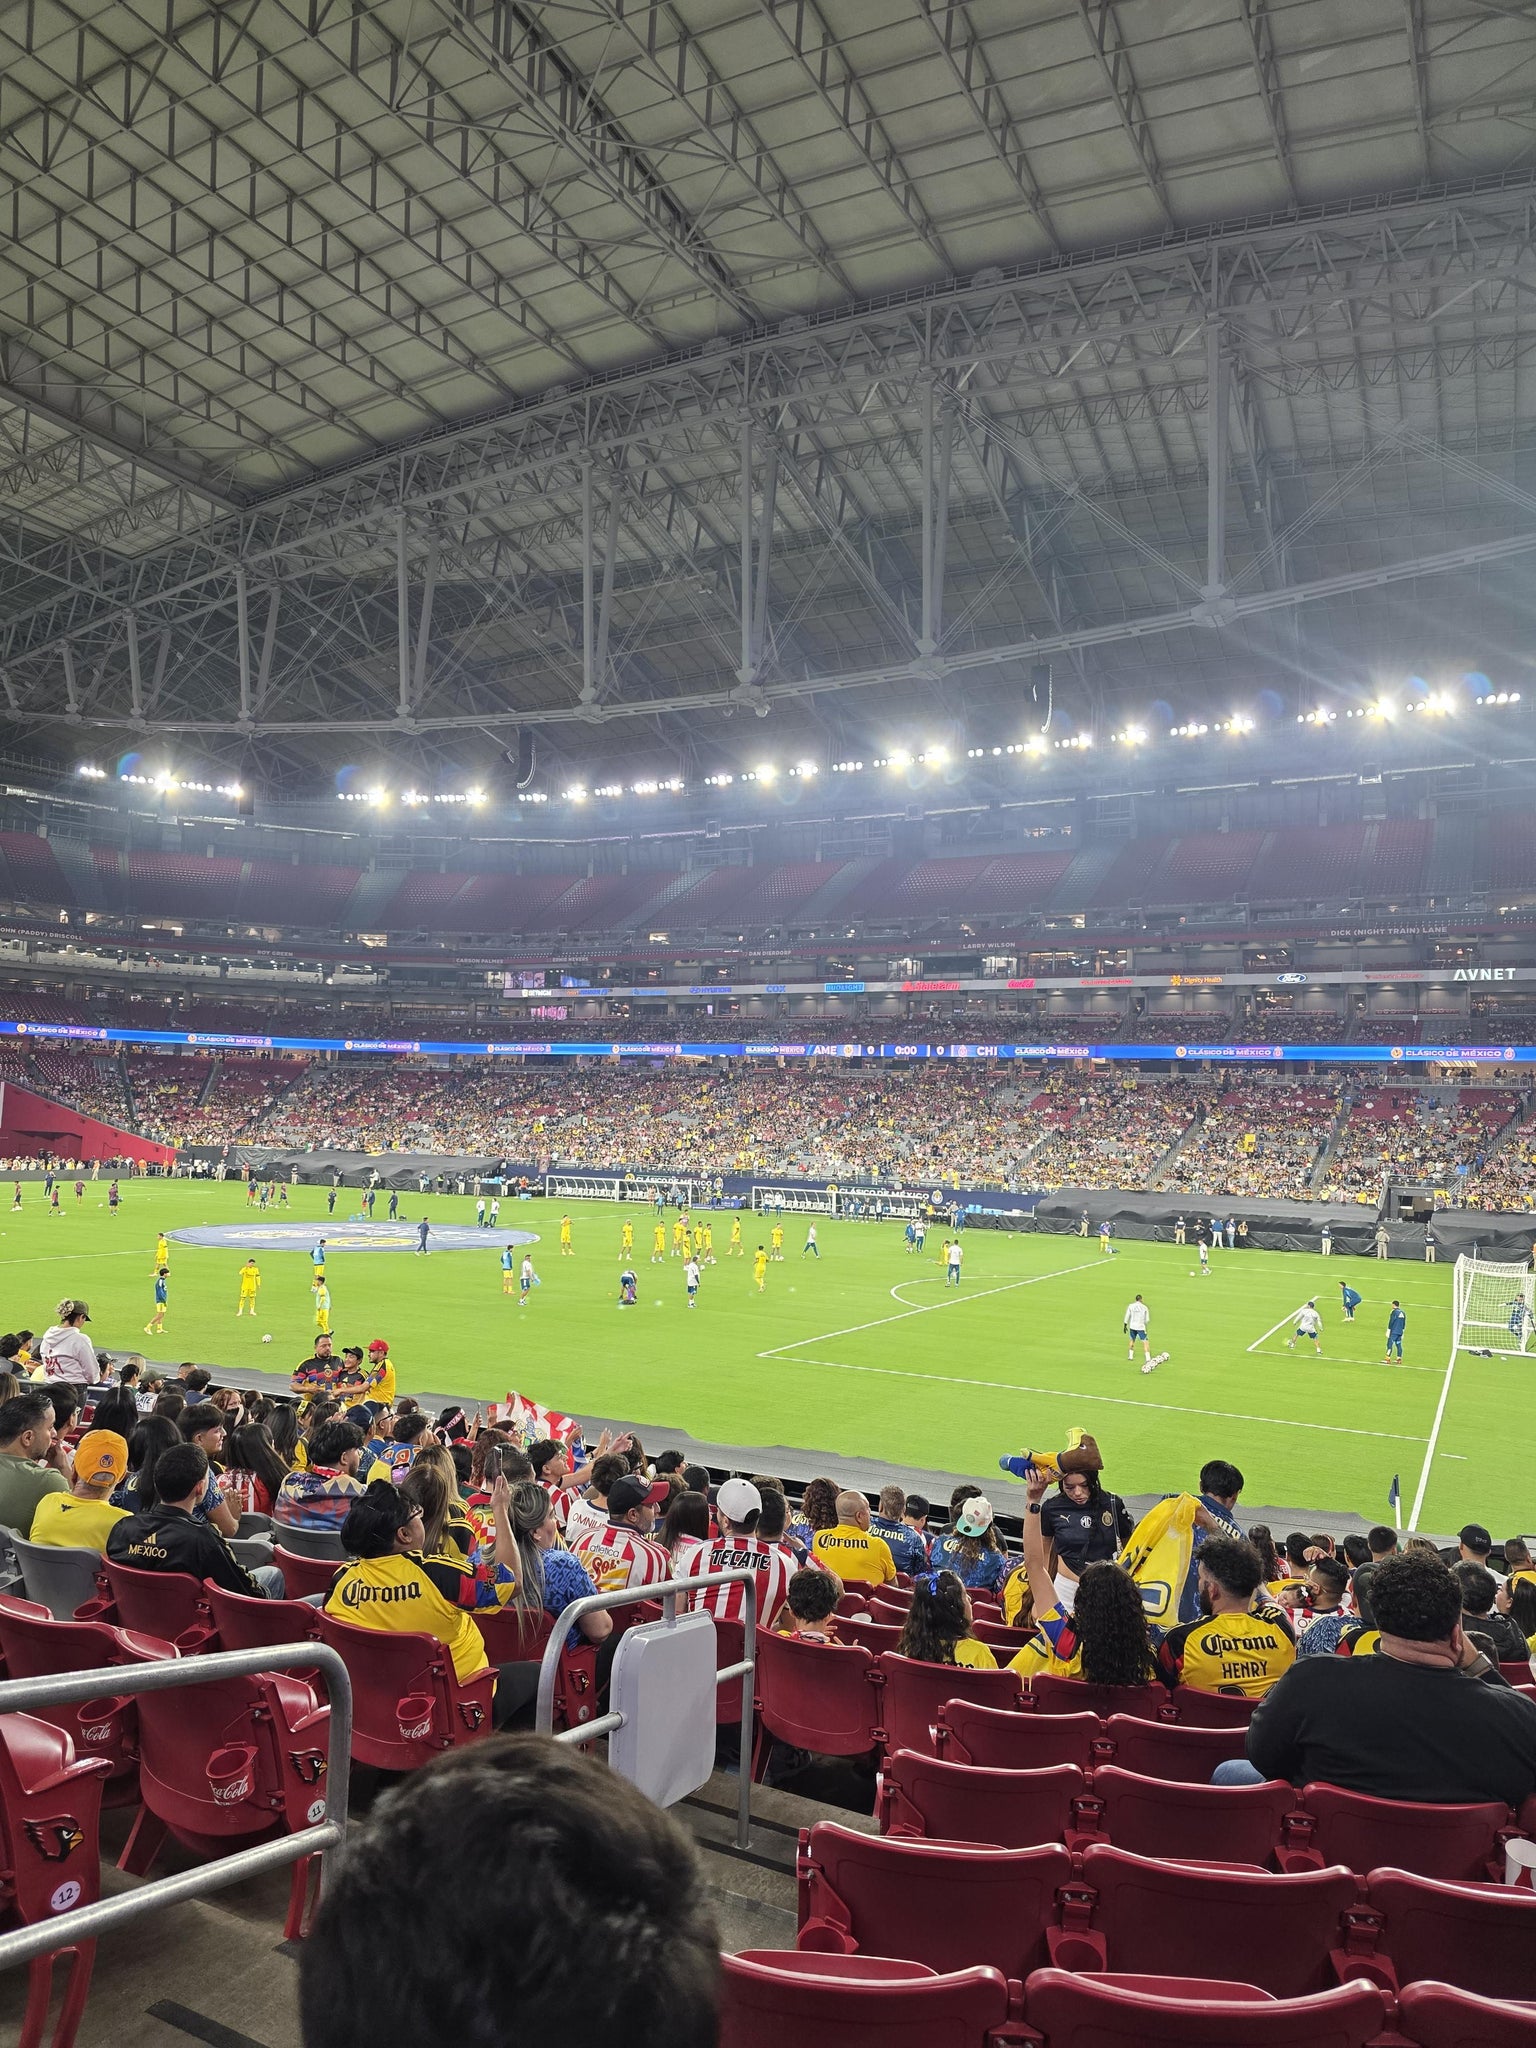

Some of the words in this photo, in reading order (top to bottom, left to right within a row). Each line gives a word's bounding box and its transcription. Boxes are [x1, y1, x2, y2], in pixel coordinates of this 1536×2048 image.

[18, 929, 48, 938] (PADDY)
[49, 932, 83, 940] DRISCOLL
[1330, 929, 1351, 937] DICK
[1353, 928, 1386, 936] (NIGHT
[1387, 927, 1420, 935] TRAIN)
[1422, 926, 1448, 934] LANE
[1453, 967, 1517, 981] AVNET
[701, 986, 732, 994] HYUNDAI
[813, 1045, 837, 1055] AME
[867, 1045, 875, 1055] 0
[894, 1045, 918, 1055] 0:00
[936, 1045, 944, 1055] 0
[976, 1046, 997, 1056] CHI
[1188, 1047, 1222, 1056] CLÁSICO
[1223, 1047, 1235, 1056] DE
[1236, 1047, 1271, 1056] MÉXICO
[1406, 1048, 1445, 1056] CLÁSICO
[1446, 1048, 1459, 1057] DE
[1461, 1048, 1502, 1057] MÉXICO
[818, 1534, 869, 1551] Corona
[128, 1544, 167, 1559] MEXICO
[589, 1545, 620, 1558] atletica
[709, 1549, 771, 1572] TECATE
[341, 1577, 422, 1610] Corona
[1201, 1633, 1279, 1658] Corona
[1222, 1661, 1268, 1679] HENRY
[311, 1806, 323, 1818] 11
[58, 1887, 74, 1904] 12
